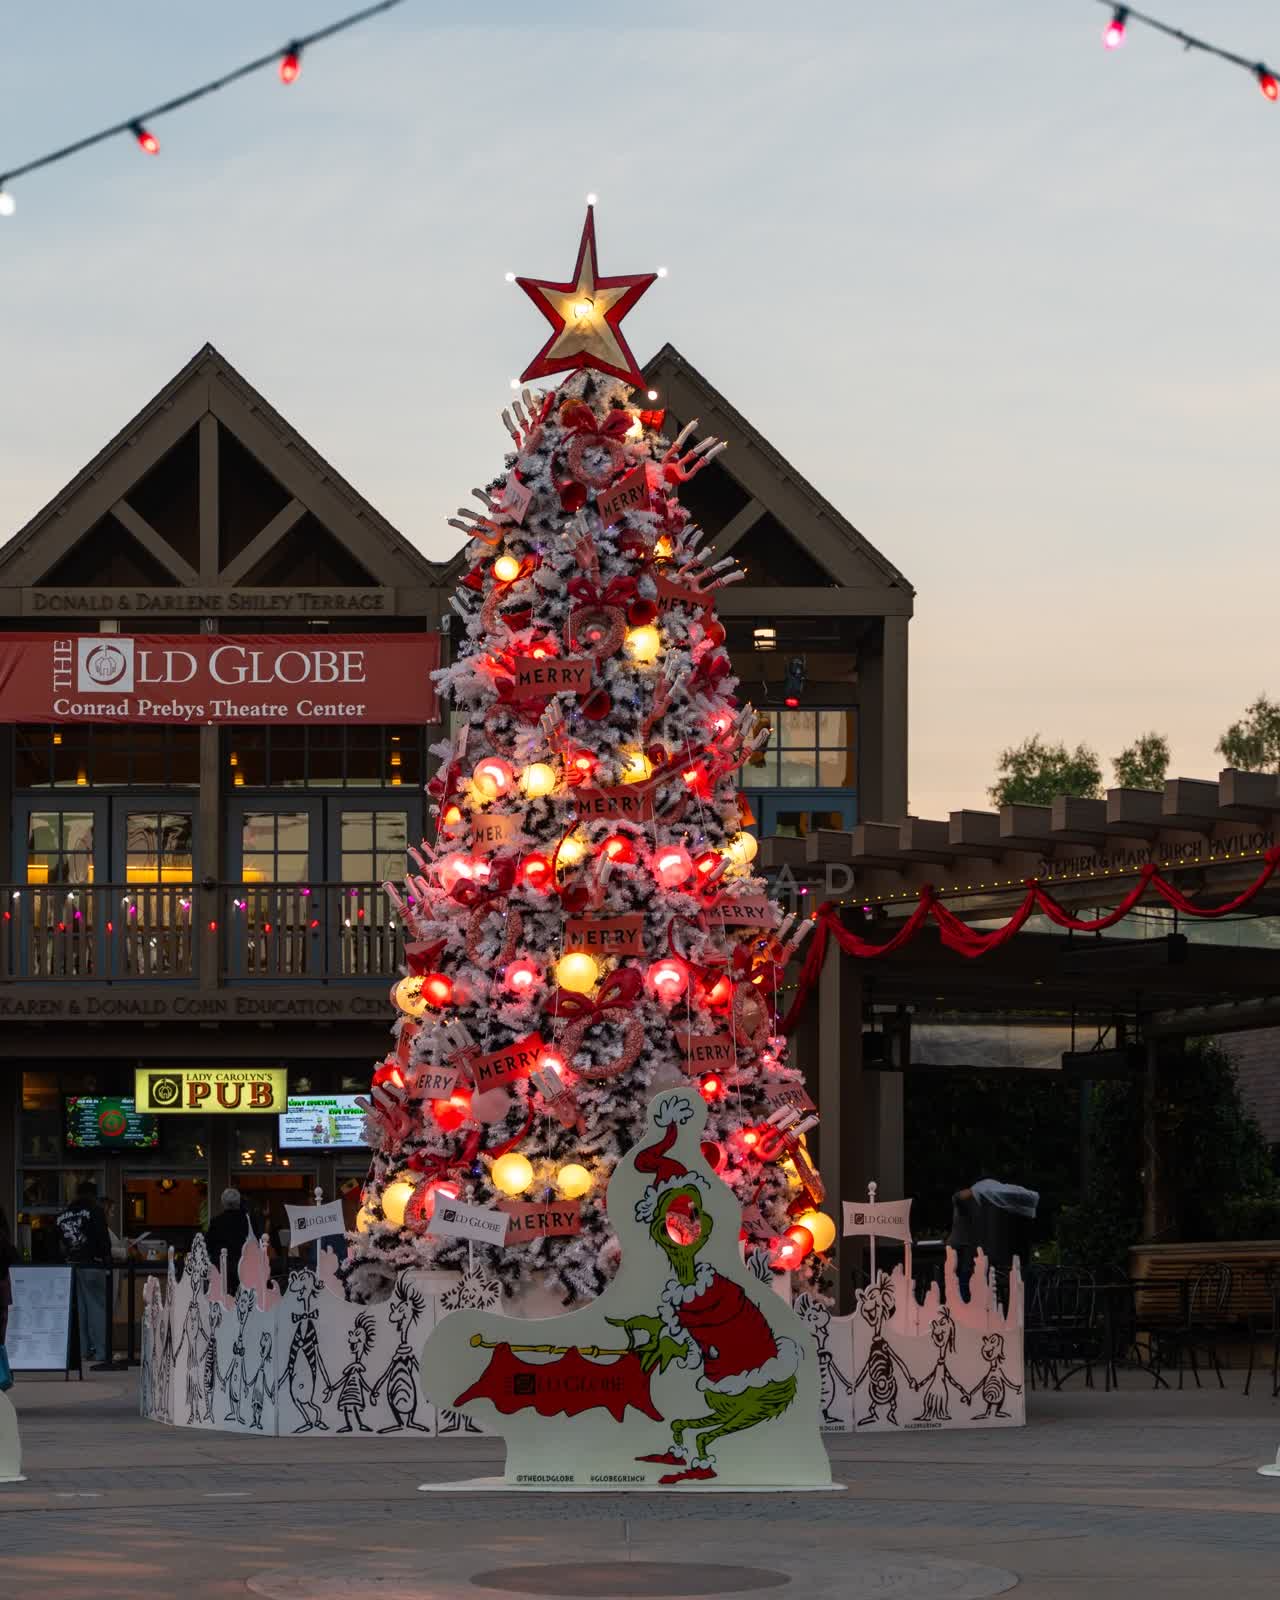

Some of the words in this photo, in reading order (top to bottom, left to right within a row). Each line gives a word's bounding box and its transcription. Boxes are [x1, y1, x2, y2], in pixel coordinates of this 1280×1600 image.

[603, 483, 646, 517] MERRY
[33, 593, 113, 611] DONALD
[119, 594, 129, 610] &
[136, 593, 220, 611] DARLENE
[228, 593, 293, 611] SHILEY
[297, 593, 384, 611] TERRACE
[53, 639, 72, 692] THE
[209, 646, 367, 685] GLOBE
[519, 668, 584, 685] MERRY
[54, 699, 129, 716] Conrad
[138, 699, 205, 721] Prebys
[210, 699, 288, 716] Theatre
[297, 699, 366, 716] Center
[579, 797, 645, 814] MERRY
[475, 824, 521, 842] MER
[1038, 855, 1097, 878] STEPHEN
[1111, 848, 1153, 867] MARY
[1160, 840, 1202, 860] BIRCH
[1208, 831, 1275, 855] PAVILION
[710, 905, 764, 918] MERRY
[571, 928, 638, 945] MERRY
[87, 997, 166, 1015] DONALD
[172, 997, 227, 1015] COHN
[236, 997, 342, 1015] EDUCATION
[349, 997, 391, 1015] CEN
[479, 1048, 540, 1080] MERRY
[186, 1073, 212, 1081] LADY
[215, 1073, 273, 1081] CAROLYN'S
[186, 1082, 274, 1108] PUB
[469, 1217, 501, 1232] GLOBE
[509, 1213, 575, 1232] MERRY
